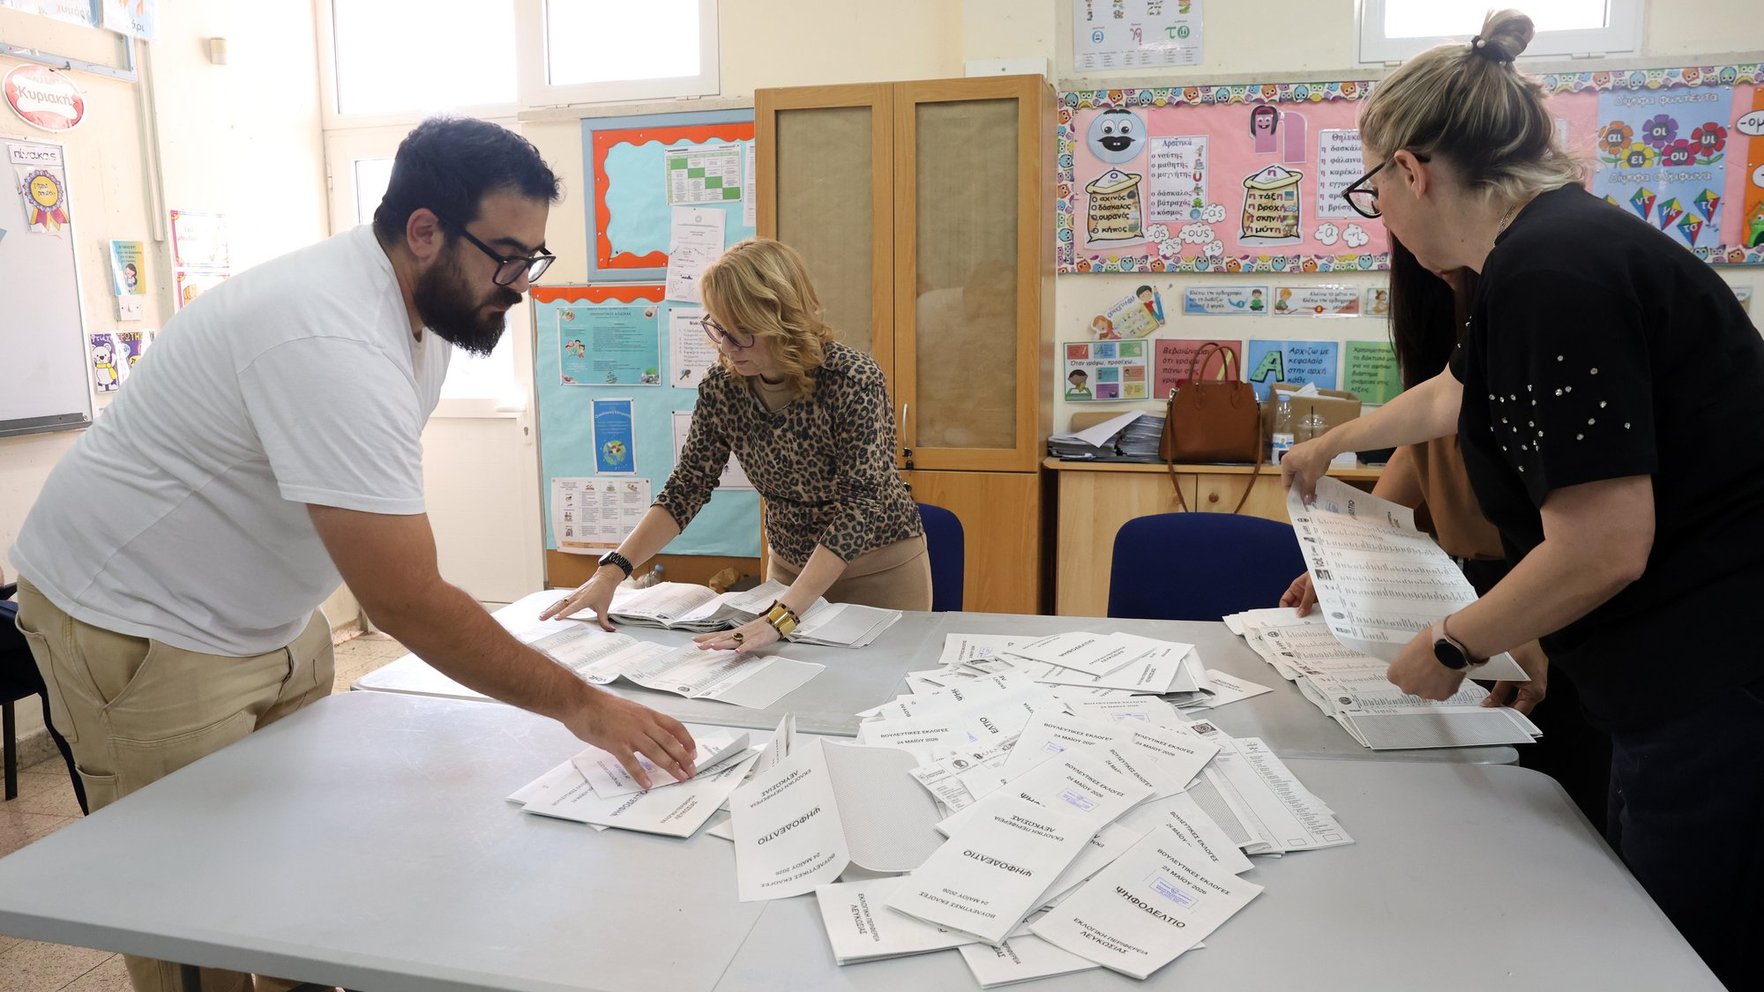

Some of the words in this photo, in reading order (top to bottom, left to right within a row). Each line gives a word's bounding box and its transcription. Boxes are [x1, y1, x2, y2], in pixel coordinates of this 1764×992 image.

[18, 85, 73, 106] Κυριακή
[1258, 192, 1283, 201] τάξη
[757, 806, 821, 845] ΨΗΦΟΔΕΛΤΙΟ
[1011, 815, 1056, 833] ΛΕΥΚΟΣΙΑΣ
[963, 850, 1032, 877] ΨΗΦΟΔΕΛΤΙΟ
[1157, 848, 1200, 878] ΒΟΥΛΕΥΤΙΚΕΣ
[1200, 876, 1231, 896] ΕΚΛΟΓΕΣ
[1170, 871, 1192, 886] ΜΑΪΟΥ
[1192, 885, 1207, 895] 2026
[1116, 885, 1186, 929] ΨΗΦΟΔΕΛΤΙΟ
[1073, 917, 1107, 939] ΕΚΛΟΓΙΚΗ
[1080, 931, 1129, 954] ΛΕΥΚΟΣΙΑΣ
